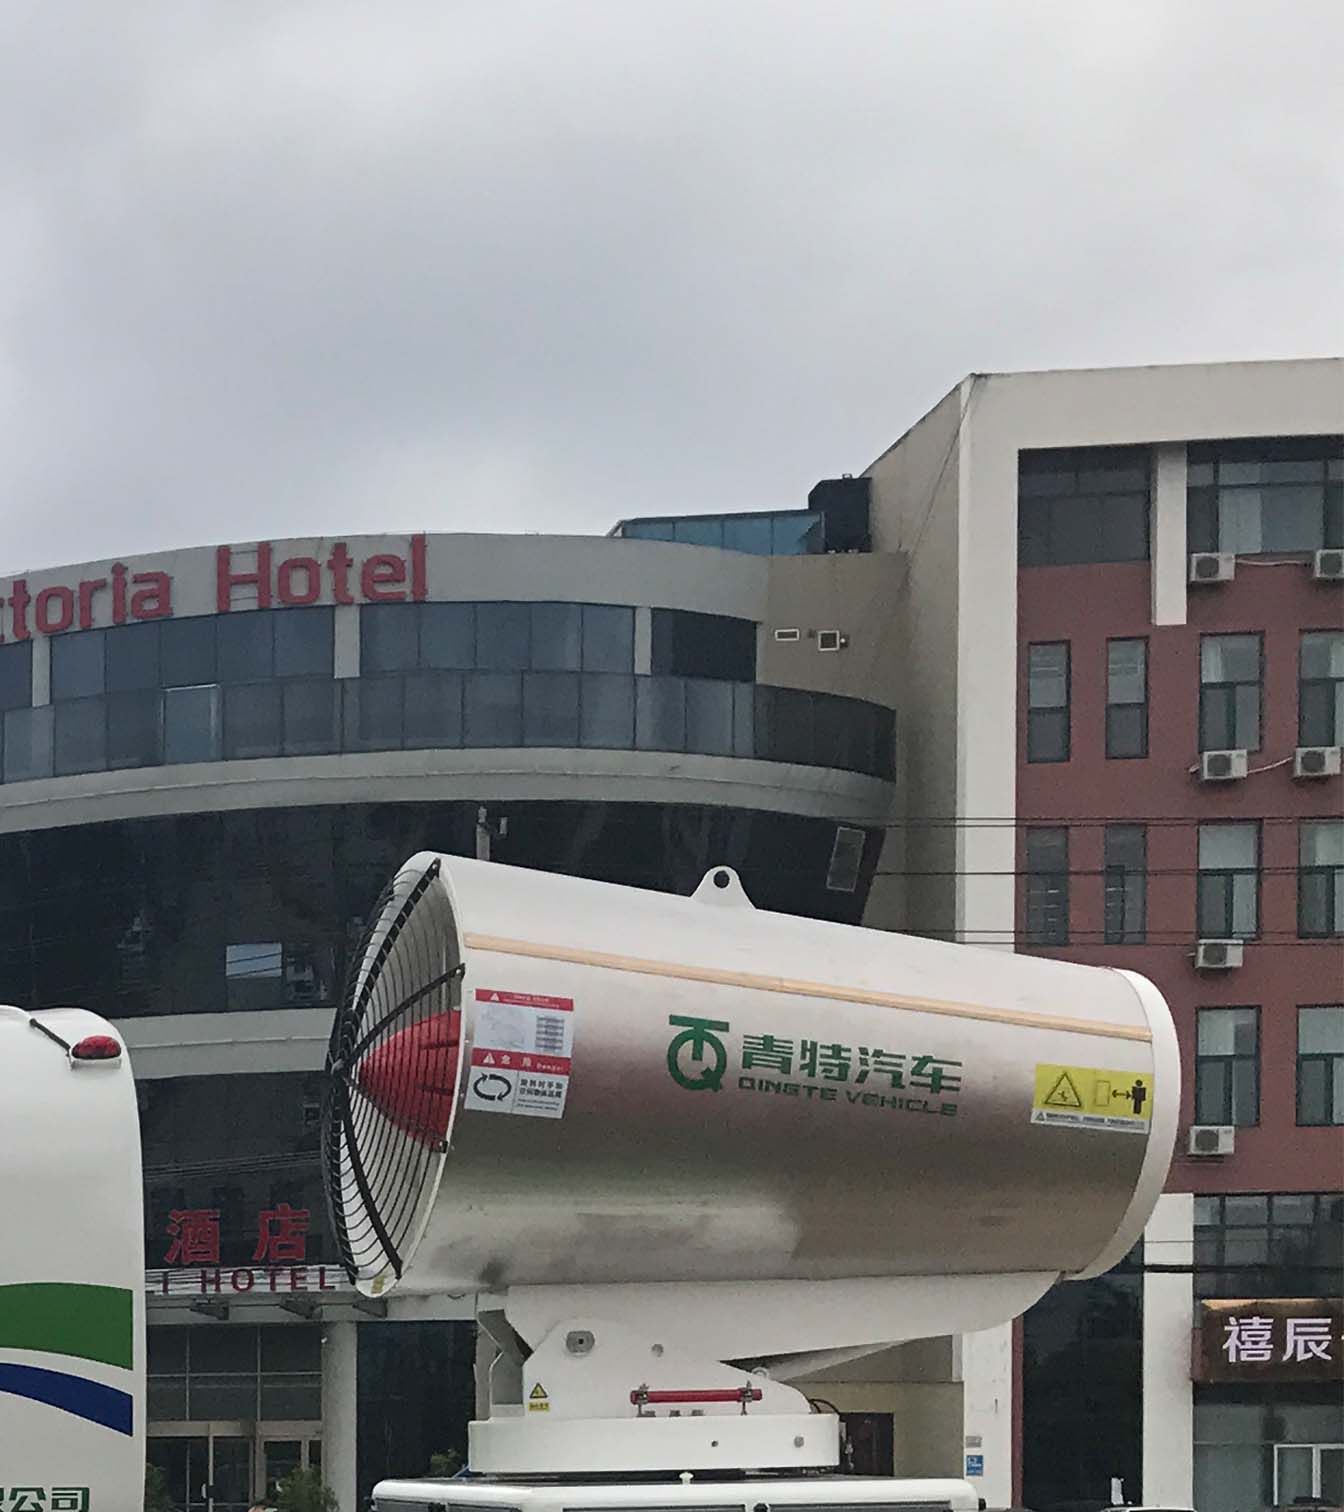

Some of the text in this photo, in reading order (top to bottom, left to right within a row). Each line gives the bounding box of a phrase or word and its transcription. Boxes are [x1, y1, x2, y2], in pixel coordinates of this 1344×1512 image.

[216, 534, 428, 613] Hotel
[742, 1034, 962, 1094] 青特汽车
[738, 1076, 958, 1117] QINGTE VEHICLE
[164, 1203, 311, 1265] 酒店
[200, 1266, 336, 1294] HOTEL
